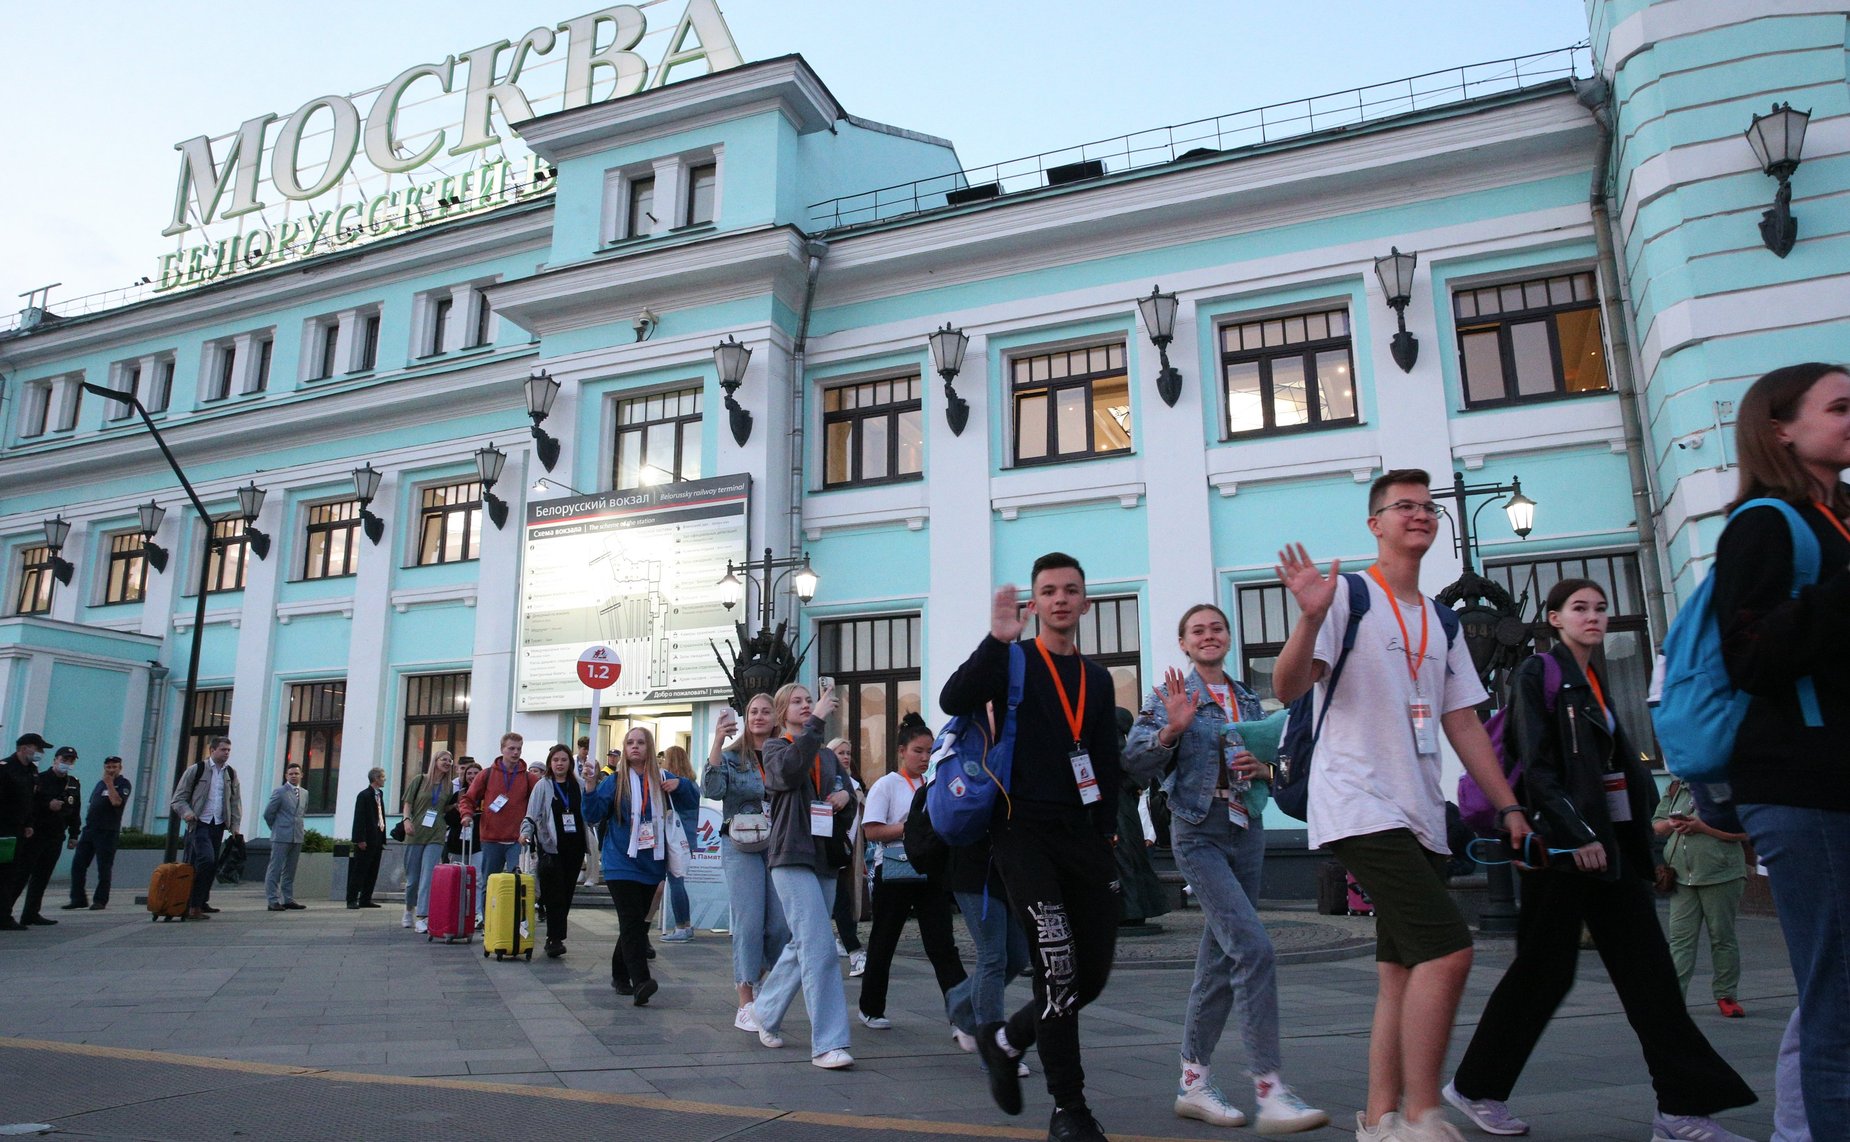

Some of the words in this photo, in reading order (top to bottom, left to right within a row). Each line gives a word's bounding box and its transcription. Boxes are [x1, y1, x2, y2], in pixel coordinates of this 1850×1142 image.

[161, 0, 745, 237] МОСКВА
[153, 156, 511, 294] БЕЛОРУССКИЙ
[660, 490, 692, 501] Belorussky
[693, 488, 717, 497] railway
[717, 482, 745, 493] terminal
[535, 497, 606, 518] Белорусский
[609, 493, 650, 508] вокзал
[533, 529, 554, 538] Схема
[555, 526, 582, 535] вокзала
[587, 665, 610, 680] 1.2
[653, 690, 673, 699] Добро
[673, 688, 709, 697] пожаловать!
